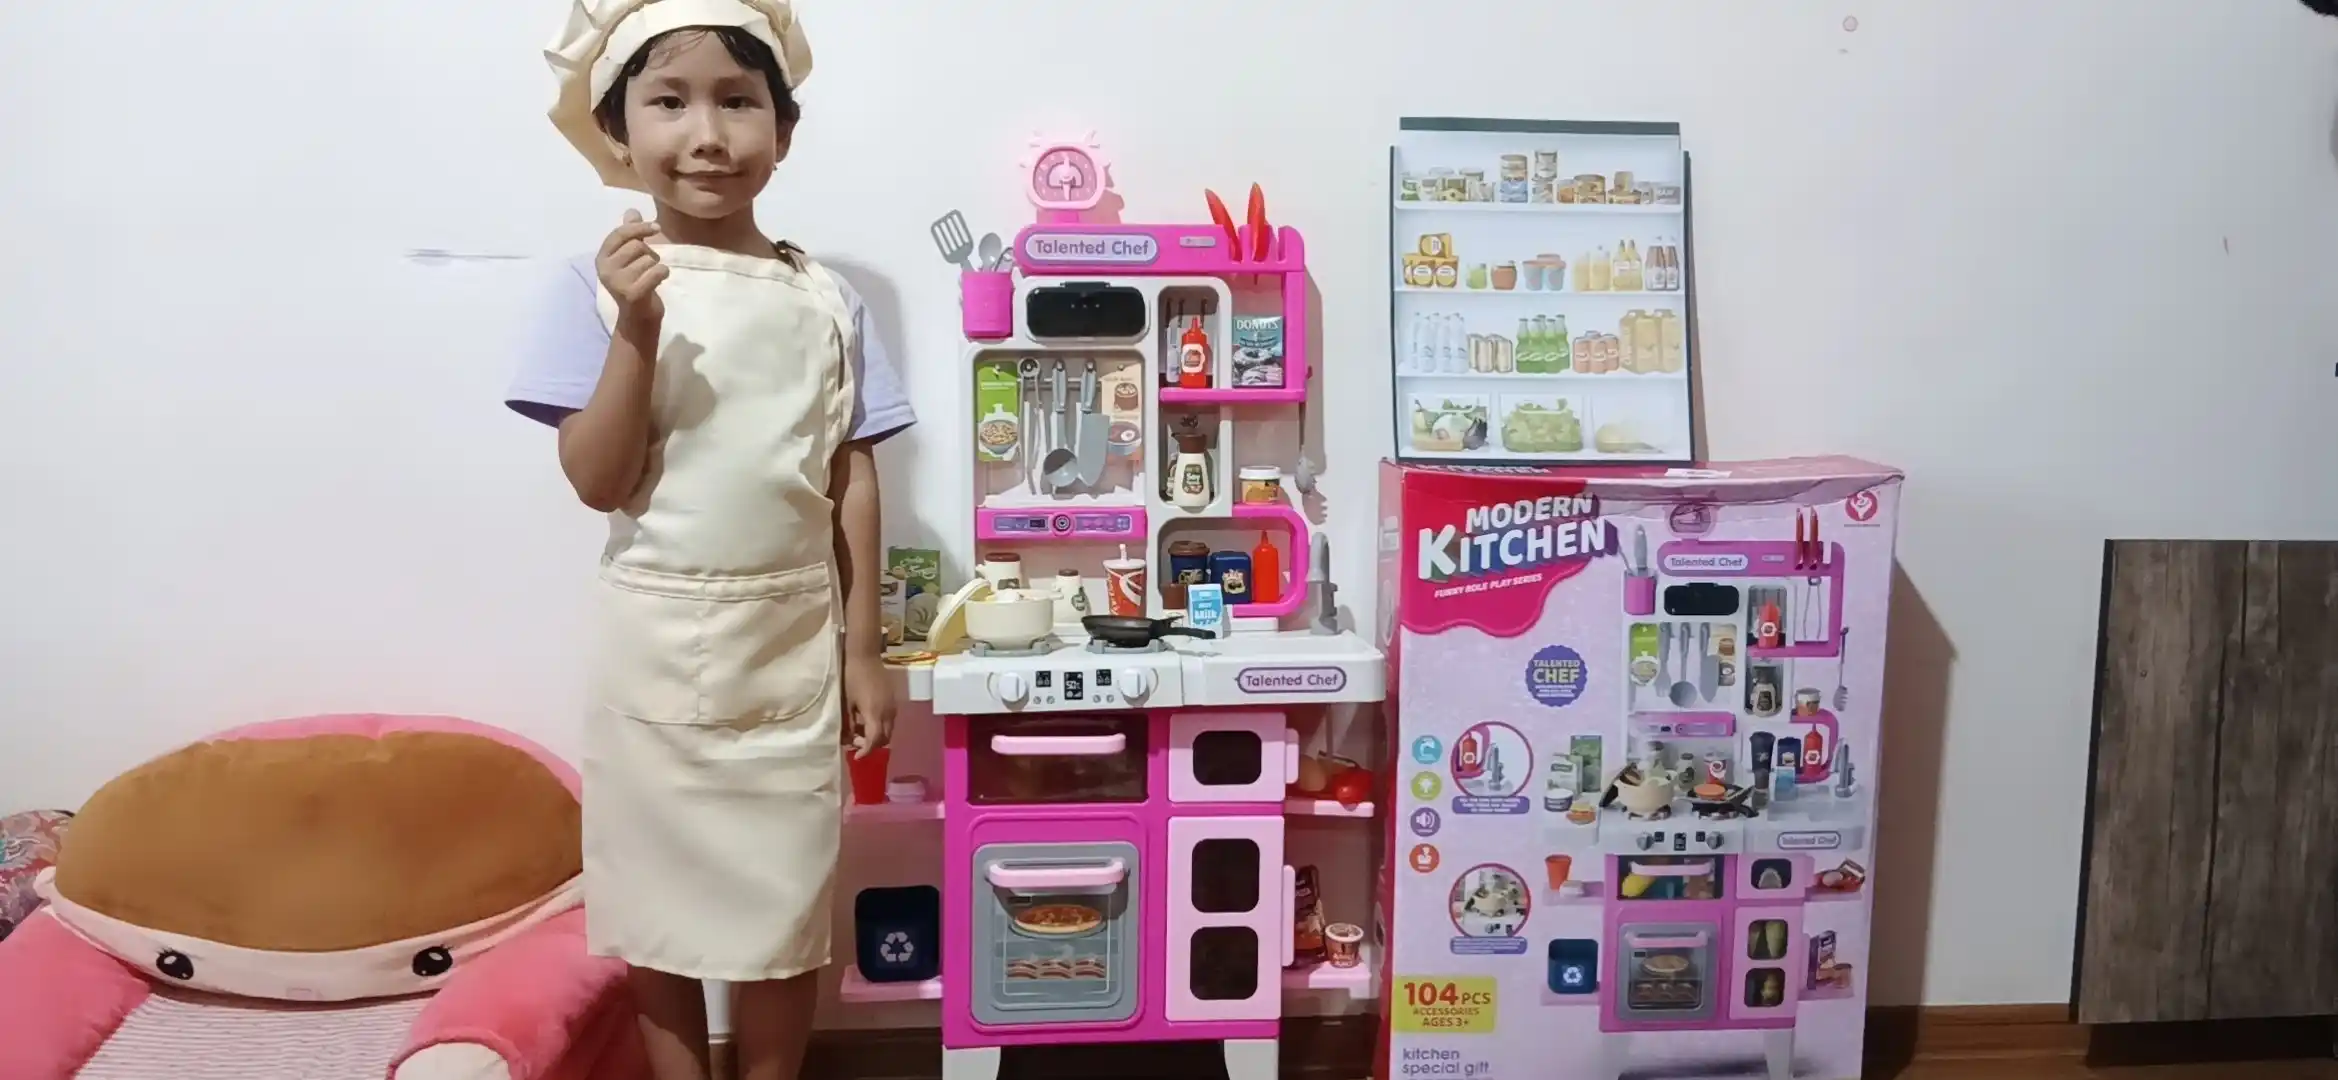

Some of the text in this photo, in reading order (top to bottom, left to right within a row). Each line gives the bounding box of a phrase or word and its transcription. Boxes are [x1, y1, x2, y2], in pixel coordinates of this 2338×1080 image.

[1035, 239, 1149, 255] Talented Chef
[1464, 493, 1593, 534] MODERN
[1417, 517, 1606, 580] KITCHEN
[1490, 578, 1513, 591] PLAY
[1245, 673, 1338, 687] Talented Chef
[1532, 668, 1580, 684] CHEF
[1404, 982, 1492, 1006] 104 PCS
[1413, 1007, 1480, 1016] ACCESSORIES
[1422, 1017, 1453, 1027] AGES
[1402, 1048, 1460, 1060] kitchen
[1401, 1061, 1490, 1077] special gift
